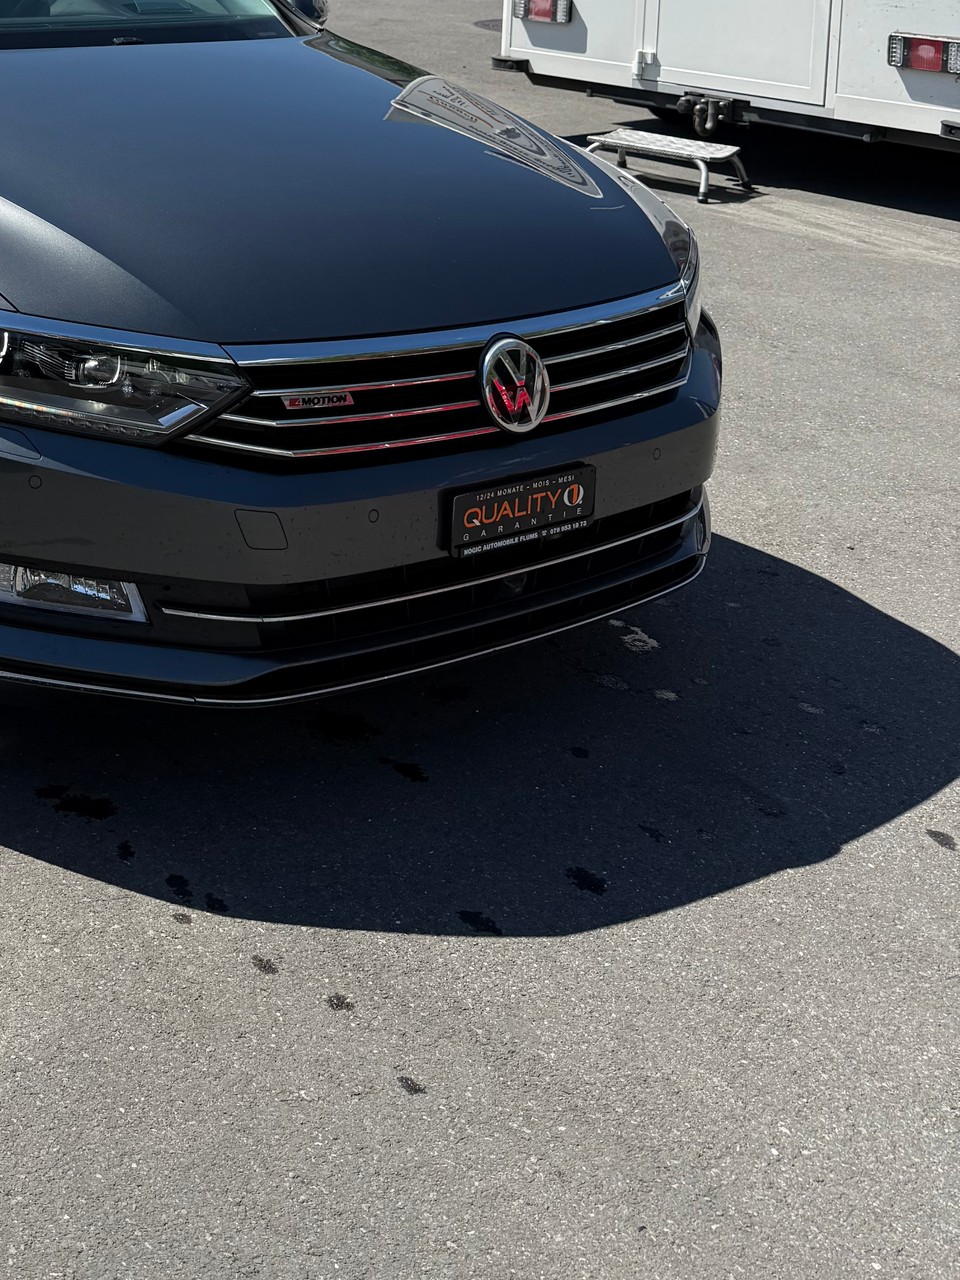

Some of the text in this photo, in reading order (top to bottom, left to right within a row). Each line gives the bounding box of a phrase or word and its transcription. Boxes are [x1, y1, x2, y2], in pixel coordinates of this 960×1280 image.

[293, 394, 348, 407] 4MOTION
[497, 485, 524, 497] MONATE
[532, 479, 550, 489] MOIS
[558, 475, 575, 484] MESI
[463, 489, 562, 529] QUALITY
[463, 507, 582, 541] GARANTIE
[482, 536, 519, 551] AUTOMOBILE
[519, 532, 538, 542] FLUMS
